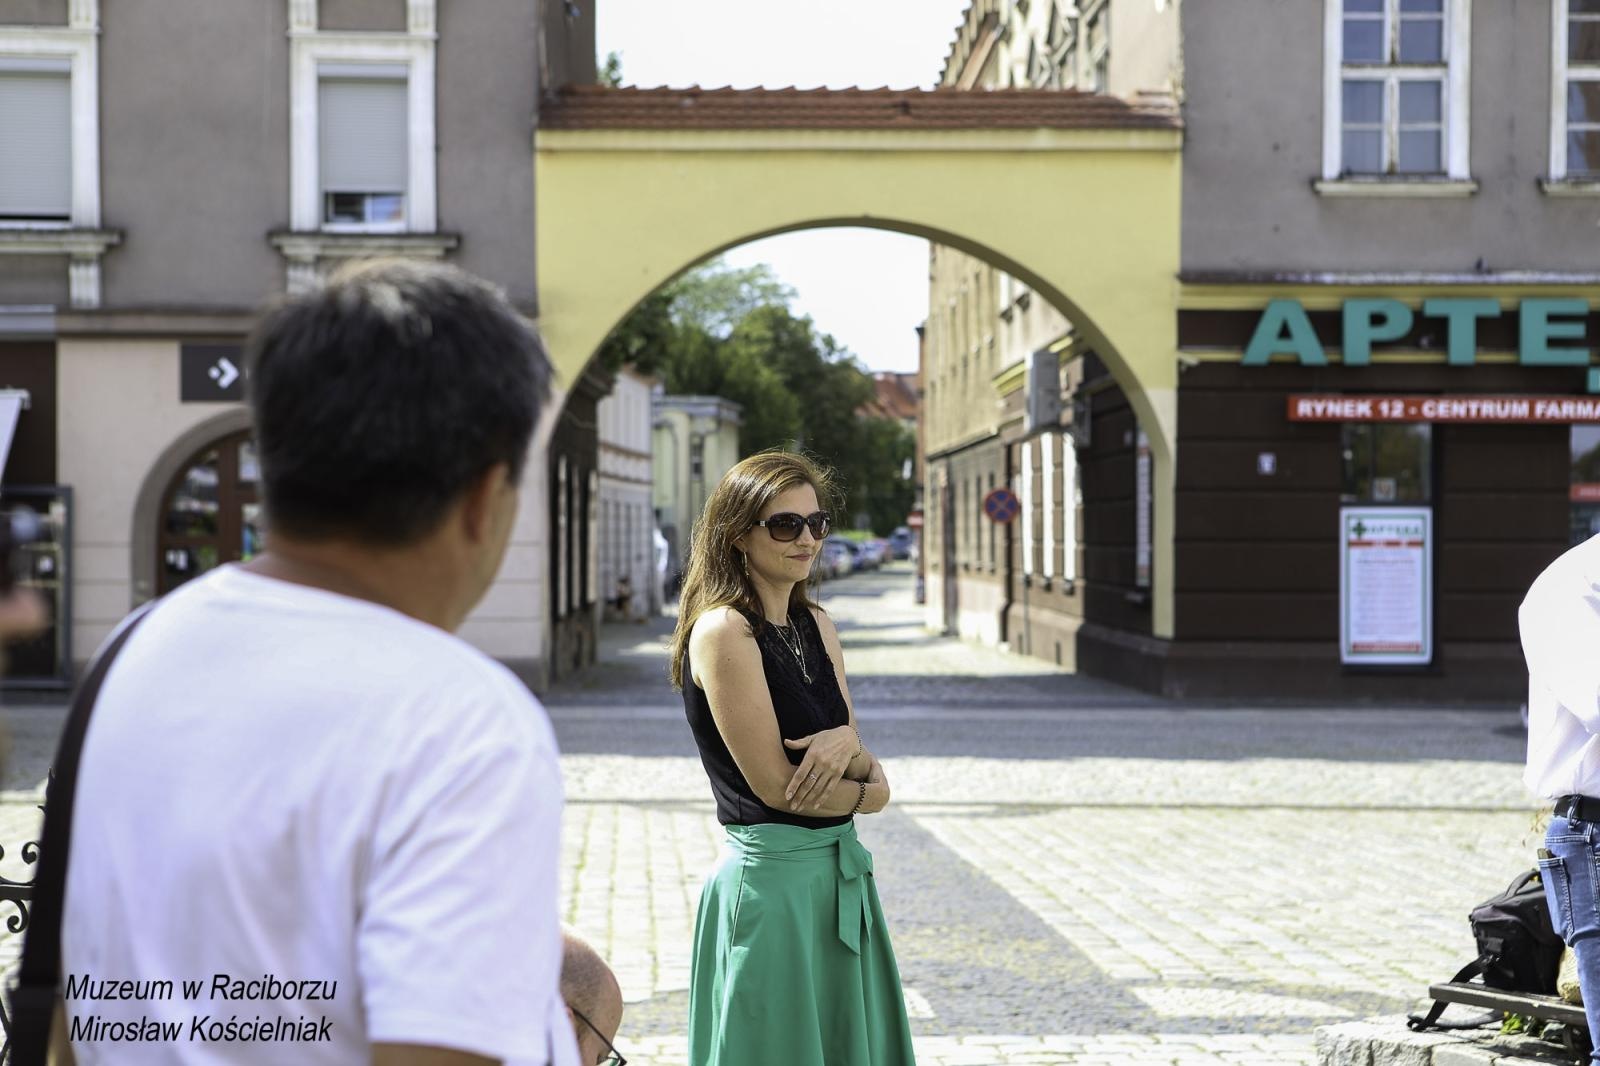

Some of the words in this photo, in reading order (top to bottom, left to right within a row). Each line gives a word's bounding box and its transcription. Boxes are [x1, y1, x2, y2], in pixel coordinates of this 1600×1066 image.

[1242, 298, 1590, 365] APTE
[1297, 399, 1373, 418] RYNEK
[1379, 399, 1404, 418] 12
[1421, 399, 1529, 418] CENTRUM
